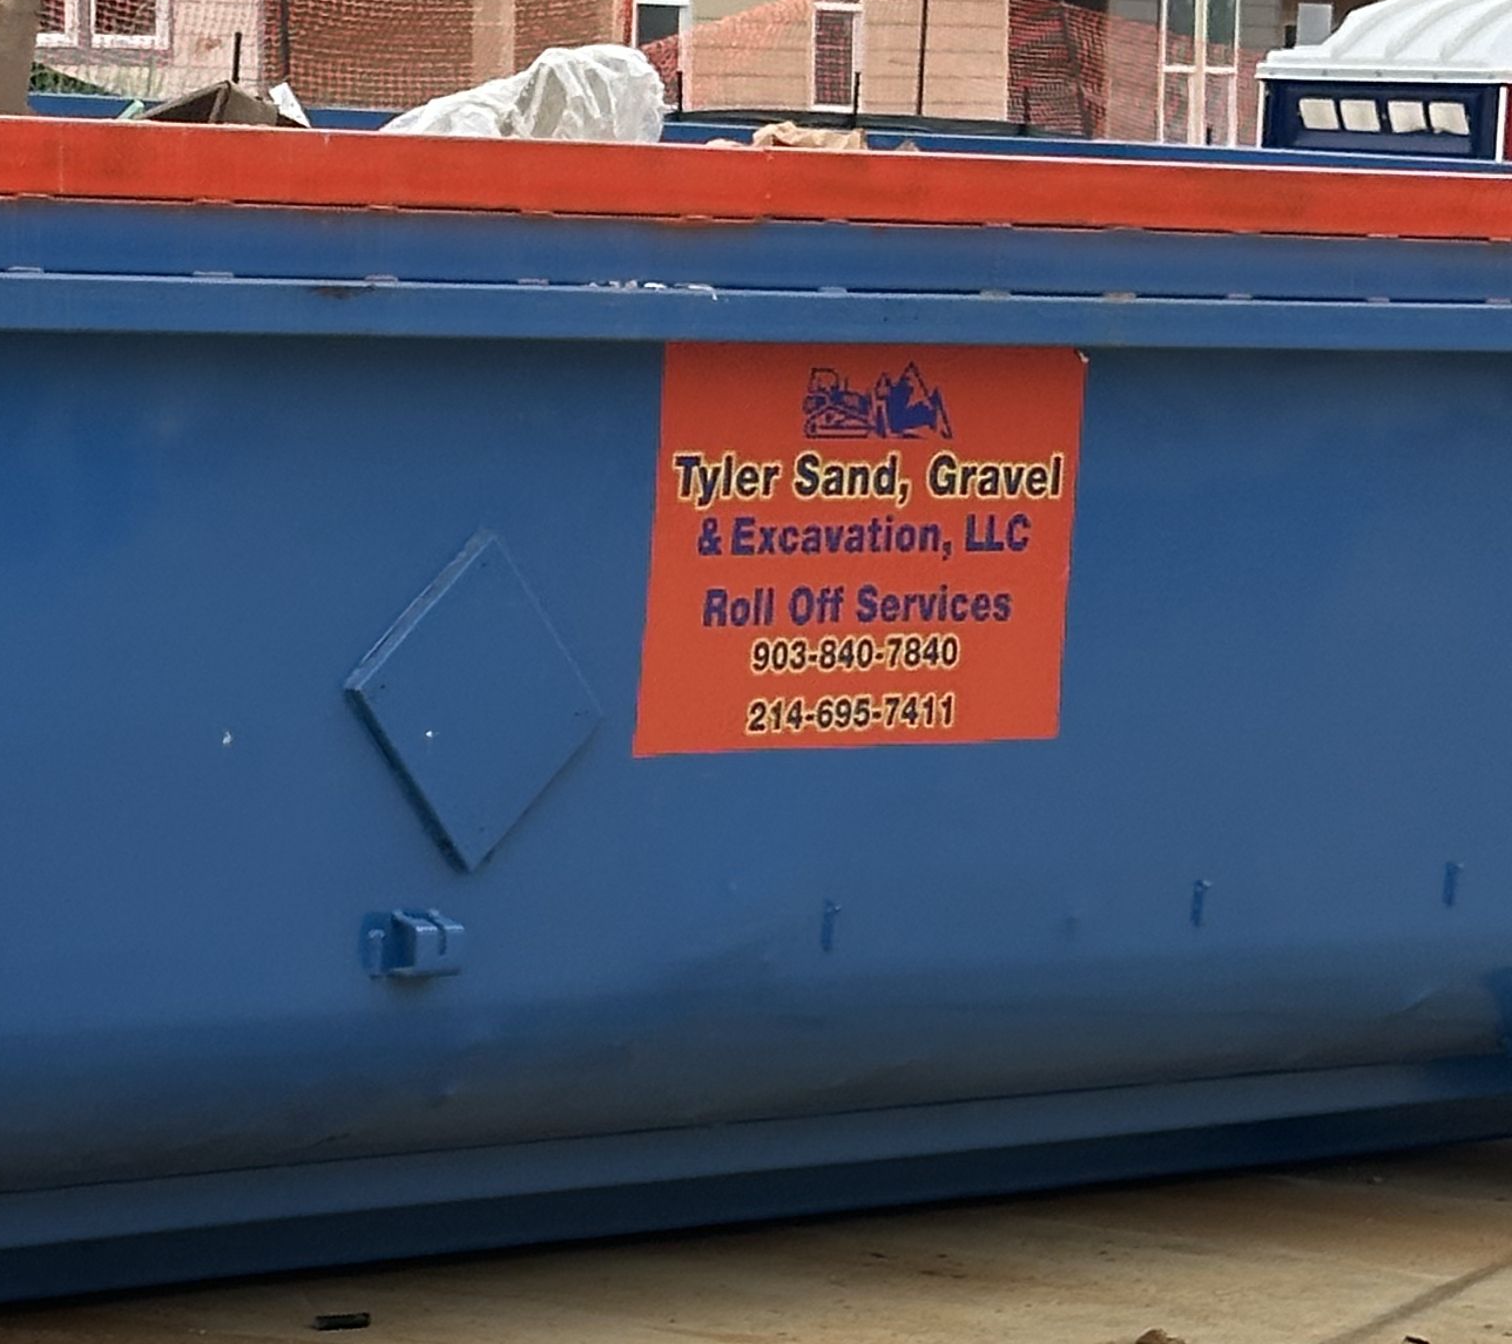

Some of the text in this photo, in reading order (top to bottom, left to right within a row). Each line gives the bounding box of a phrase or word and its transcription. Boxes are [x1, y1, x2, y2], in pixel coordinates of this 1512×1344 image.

[674, 452, 1062, 508] Tyler Sand, Gravel
[697, 513, 1031, 561] & Excavation, LLC
[702, 584, 1012, 627] Roll Off Services
[751, 635, 959, 673] 903-840-7840
[746, 693, 955, 733] 214-695-7411
